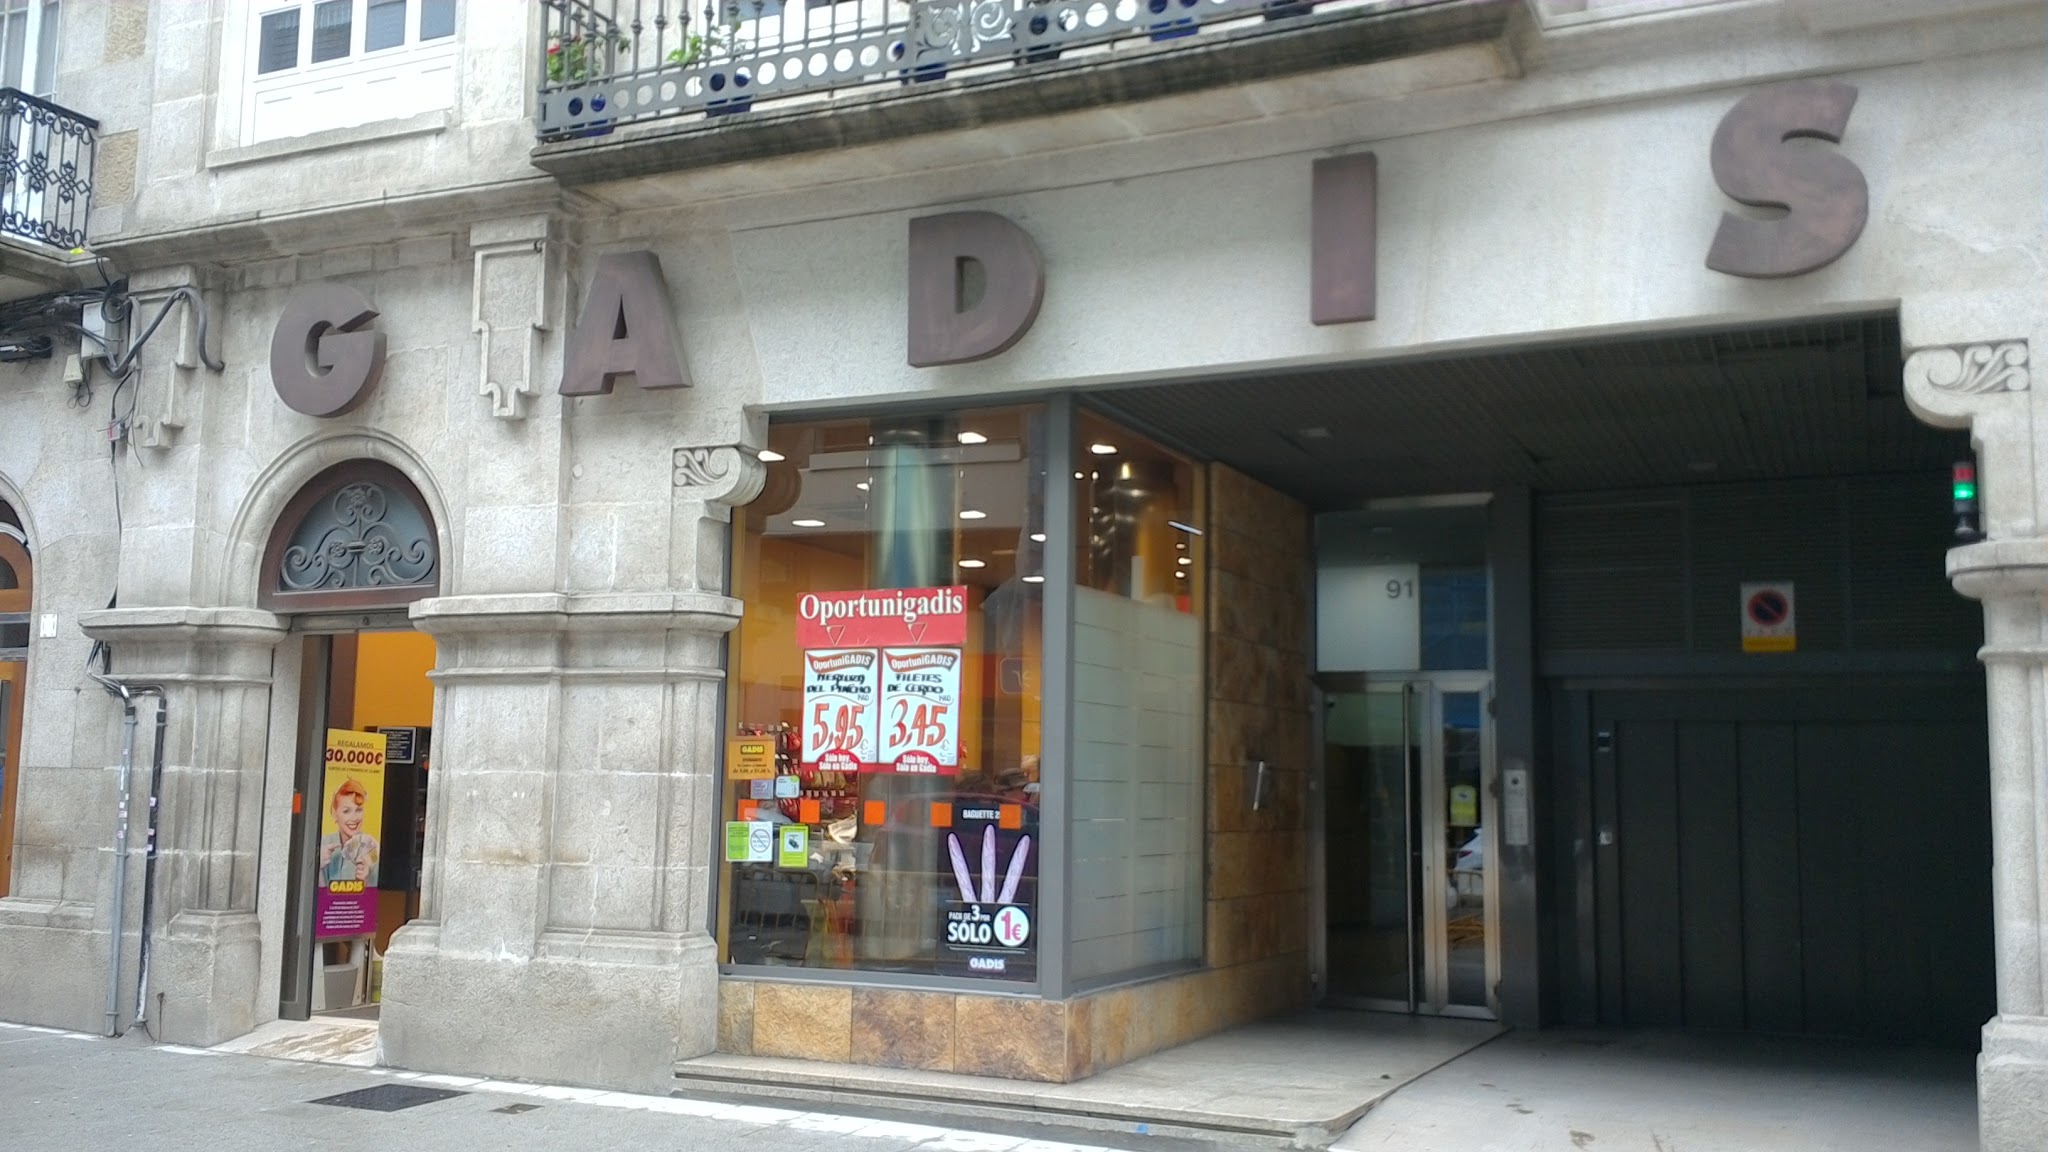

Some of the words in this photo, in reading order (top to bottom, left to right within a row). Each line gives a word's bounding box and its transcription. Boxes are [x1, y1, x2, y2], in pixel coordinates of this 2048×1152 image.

[270, 80, 1868, 418] GADIS
[1387, 580, 1413, 598] 91
[800, 588, 963, 626] Oportunigadis
[813, 654, 871, 670] OportuniGADIS
[892, 654, 953, 670] OportuniGADIS
[896, 673, 942, 683] FILETES
[807, 685, 826, 693] DEL
[887, 684, 901, 692] DE
[905, 684, 944, 695] CERDO
[812, 703, 864, 751] 5,95
[889, 699, 948, 748] 3,45
[338, 740, 374, 749] REGALAMOS
[741, 745, 764, 753] GADIS
[325, 748, 383, 765] 30.000€
[962, 809, 994, 820] BAGUETTE
[329, 881, 363, 893] GADIS
[948, 911, 962, 920] PACK
[963, 912, 971, 920] DE
[971, 904, 980, 922] 3
[947, 919, 992, 944] SÓLO
[1001, 911, 1021, 940] 1€
[969, 957, 1005, 970] GADIS
